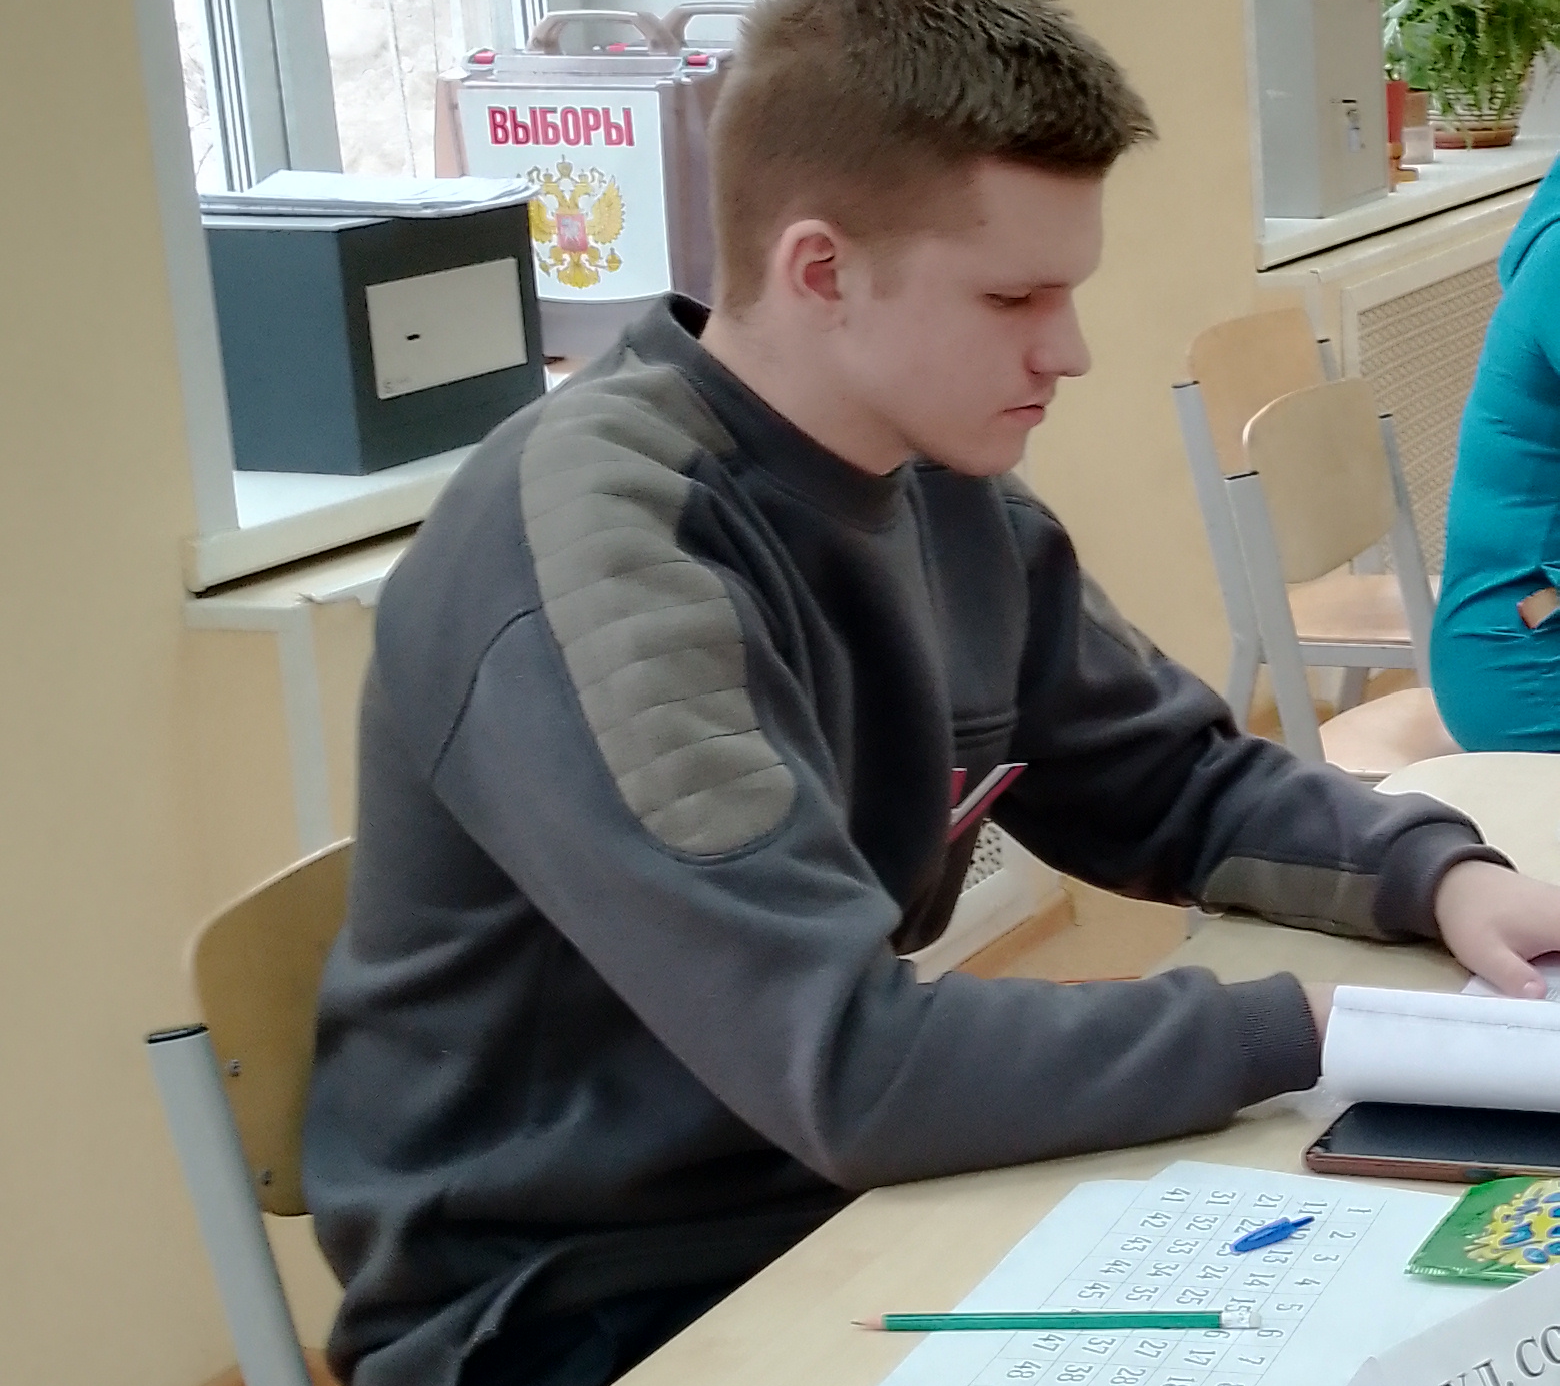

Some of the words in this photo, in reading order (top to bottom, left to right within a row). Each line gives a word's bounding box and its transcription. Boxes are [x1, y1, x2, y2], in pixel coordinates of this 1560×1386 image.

[488, 106, 635, 146] ВЫБОРЫ
[1160, 1188, 1191, 1202] 41
[1205, 1190, 1237, 1205] 31
[1253, 1193, 1284, 1208] 21
[1297, 1201, 1328, 1215] 11
[1140, 1212, 1172, 1228] 42
[1185, 1215, 1219, 1231] 32
[1329, 1230, 1357, 1239] 2
[1120, 1236, 1153, 1252] 43
[1166, 1239, 1200, 1255] 33
[1262, 1249, 1294, 1264] 13
[1313, 1254, 1340, 1262] 3
[1099, 1259, 1132, 1274] 44
[1147, 1262, 1180, 1277] 34
[1196, 1265, 1229, 1280] 24
[1242, 1272, 1276, 1287] 14
[1294, 1278, 1321, 1286] 4
[1077, 1282, 1111, 1299] 45
[1125, 1285, 1160, 1302] 35
[1175, 1288, 1210, 1306] 25
[1275, 1303, 1304, 1311] 5
[1257, 1328, 1284, 1338] 6
[1032, 1333, 1066, 1352] 47
[1082, 1336, 1117, 1355] 37
[1134, 1340, 1168, 1358] 27
[1183, 1349, 1216, 1366] 17
[1238, 1356, 1266, 1365] 7
[1006, 1360, 1042, 1379] 48
[1056, 1364, 1094, 1382] 38
[1110, 1367, 1146, 1385] 28
